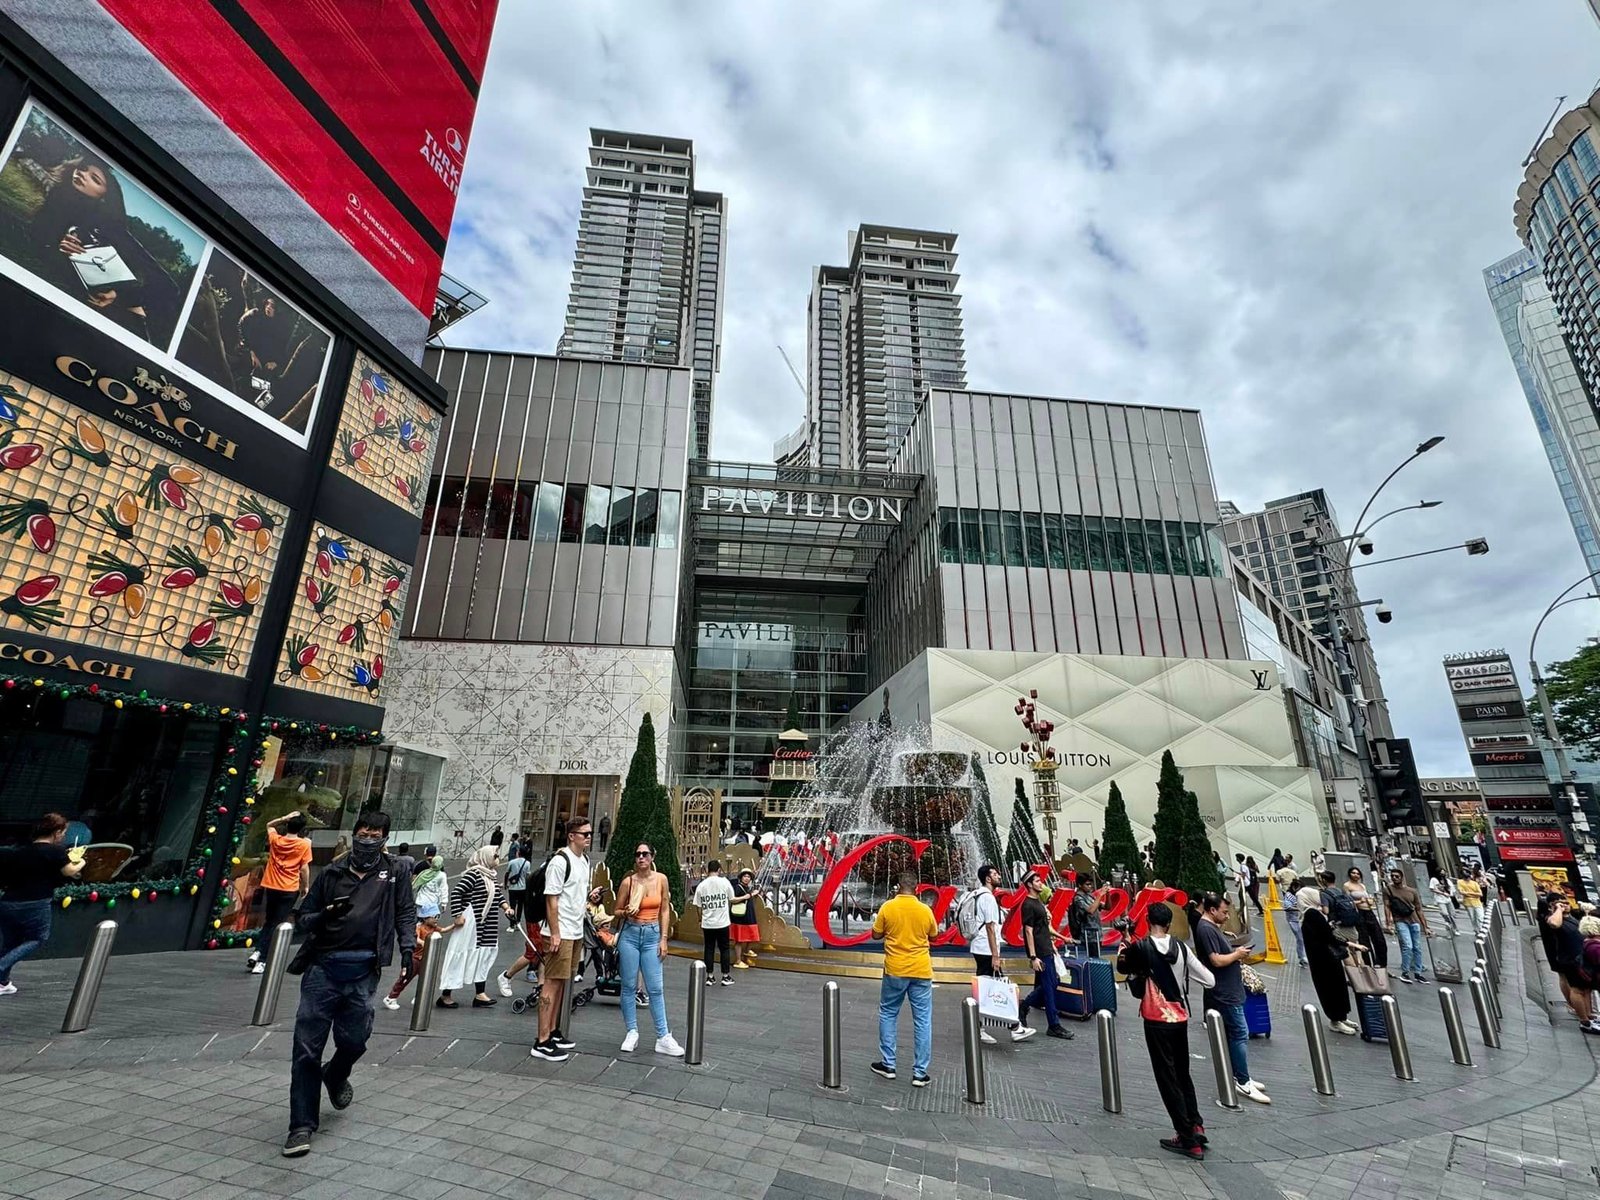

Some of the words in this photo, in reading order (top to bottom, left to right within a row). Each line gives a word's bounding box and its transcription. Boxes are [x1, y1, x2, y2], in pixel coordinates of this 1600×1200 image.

[363, 208, 390, 239] TURKISH
[389, 237, 415, 265] AIRLINES
[55, 355, 240, 461] COACH
[113, 408, 149, 431] NEW
[149, 424, 185, 449] YORK
[700, 485, 903, 523] PAVILION
[0, 642, 136, 681] COACH
[1448, 663, 1511, 677] PARKSON
[1464, 680, 1482, 688] DADI
[1482, 678, 1512, 686] CINEMA
[1475, 705, 1507, 715] PADINI
[775, 746, 814, 758] Cartier
[1485, 752, 1526, 762] Mercato
[987, 751, 1035, 766] LOUIS
[1051, 753, 1112, 767] UITTON
[559, 760, 588, 771] DIOR
[1243, 815, 1266, 823] LOUIS
[1267, 815, 1300, 824] VUITTON
[1513, 831, 1545, 839] METERED
[700, 893, 727, 903] NOMAD
